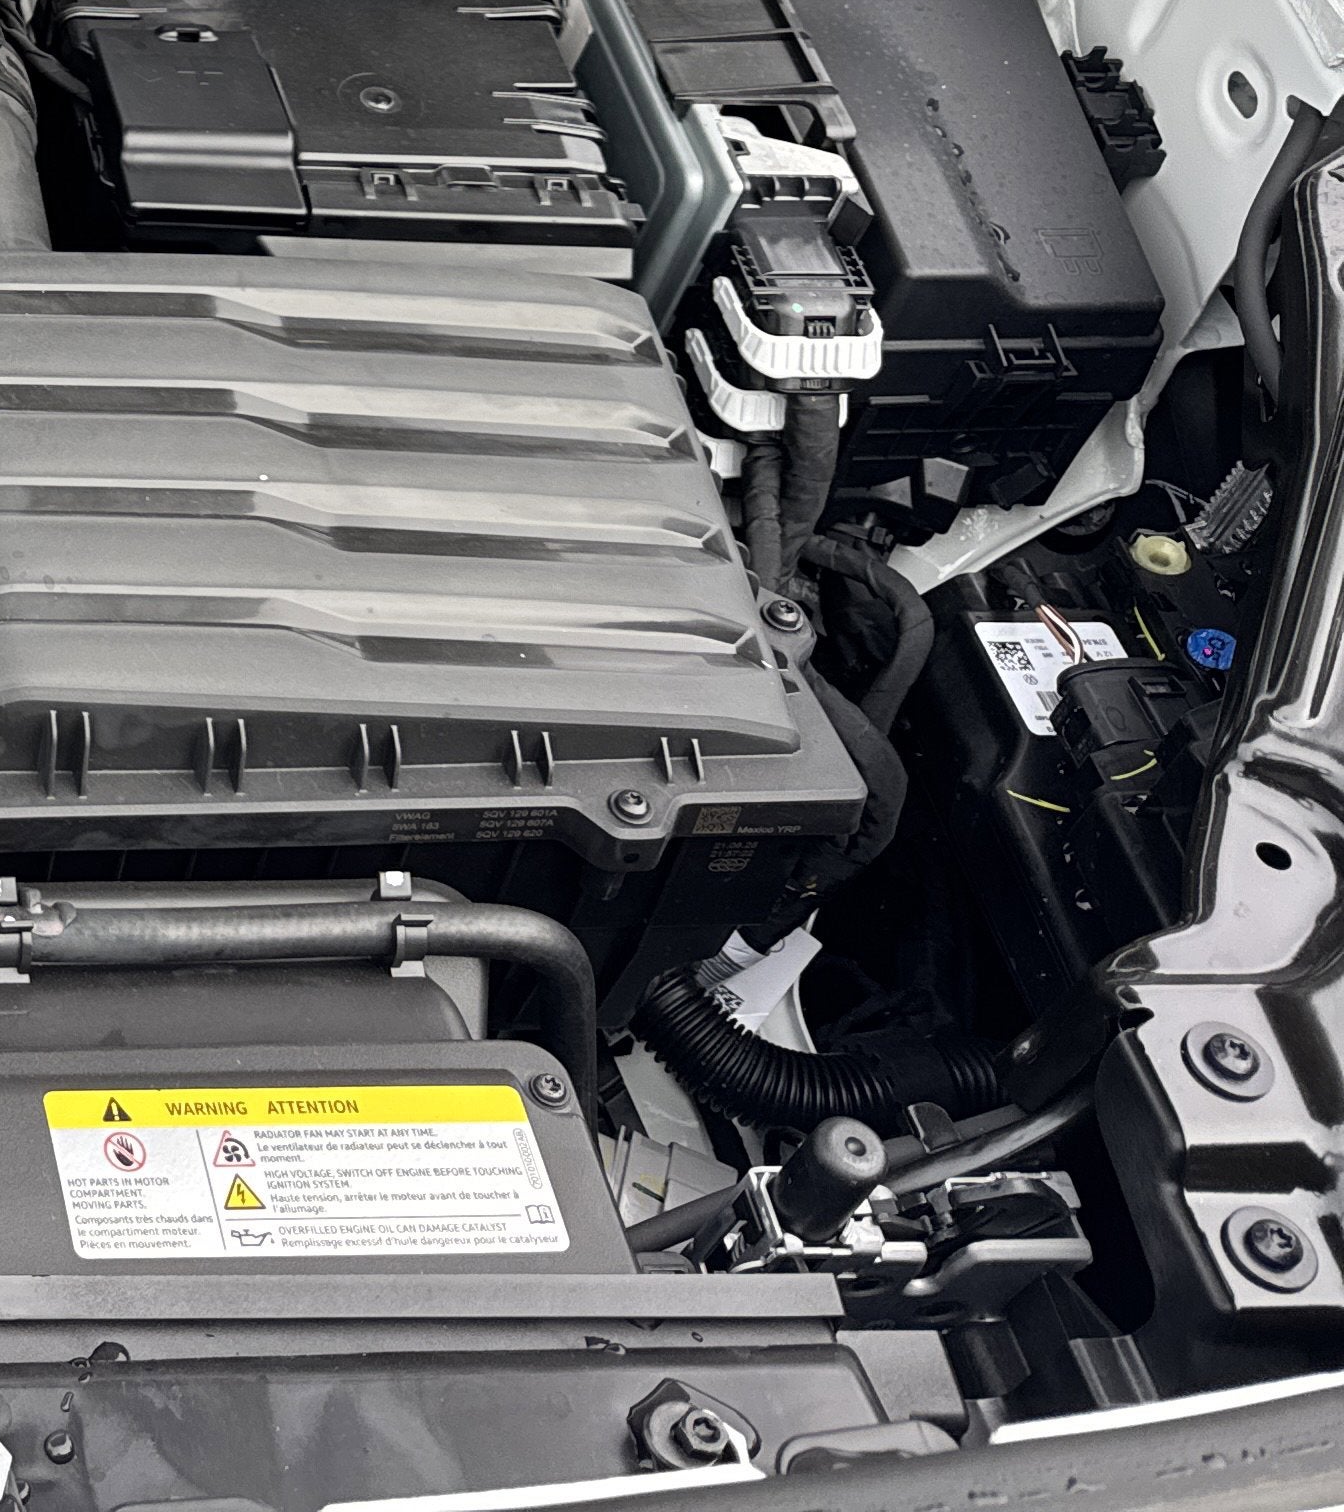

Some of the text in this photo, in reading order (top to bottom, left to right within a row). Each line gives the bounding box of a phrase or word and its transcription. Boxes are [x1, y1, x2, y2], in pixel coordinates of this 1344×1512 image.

[165, 1099, 359, 1116] WARNING ATTENTION
[254, 1130, 301, 1139] RADIATOR
[303, 1129, 323, 1139] FAN
[325, 1129, 345, 1138] MAY
[347, 1128, 375, 1138] START
[377, 1128, 390, 1138] AT
[391, 1128, 409, 1137] ANY
[257, 1143, 269, 1152] Le
[271, 1142, 323, 1152] ventilateur
[325, 1141, 338, 1151] de
[340, 1141, 384, 1150] radiateur
[387, 1141, 408, 1151] peut
[424, 1140, 476, 1150] déclencher
[486, 1140, 508, 1149] tout
[264, 1169, 288, 1179] HIGH
[336, 1168, 373, 1178] SWITCH
[375, 1168, 393, 1177] OFF
[396, 1168, 432, 1177] ENGINE
[433, 1167, 471, 1177] BEFORE
[473, 1166, 523, 1176] TOUCHING
[67, 1176, 170, 1187] HOT PARTS IN MOTOR
[267, 1180, 311, 1190] IGNITION
[270, 1193, 300, 1202] Haute
[344, 1191, 378, 1202] arrêter
[379, 1191, 389, 1201] le
[391, 1191, 426, 1201] moteur
[429, 1191, 457, 1200] avant
[459, 1190, 471, 1199] de
[472, 1190, 510, 1199] toucher
[72, 1200, 112, 1210] MOVING
[75, 1213, 213, 1227] Composants très chauds dans
[77, 1227, 87, 1236] le
[89, 1227, 160, 1239] compartiment
[279, 1223, 507, 1235] OVERFILLED ENGINE OIL CAN DAMAGE CATALYST
[80, 1238, 112, 1249] Pièces
[114, 1240, 126, 1249] en
[281, 1237, 343, 1249] Remplissage
[345, 1237, 383, 1247] excessif
[420, 1235, 472, 1247] dangereux
[474, 1236, 497, 1246] pour
[499, 1235, 507, 1244] le
[509, 1234, 559, 1245] catalyseur
